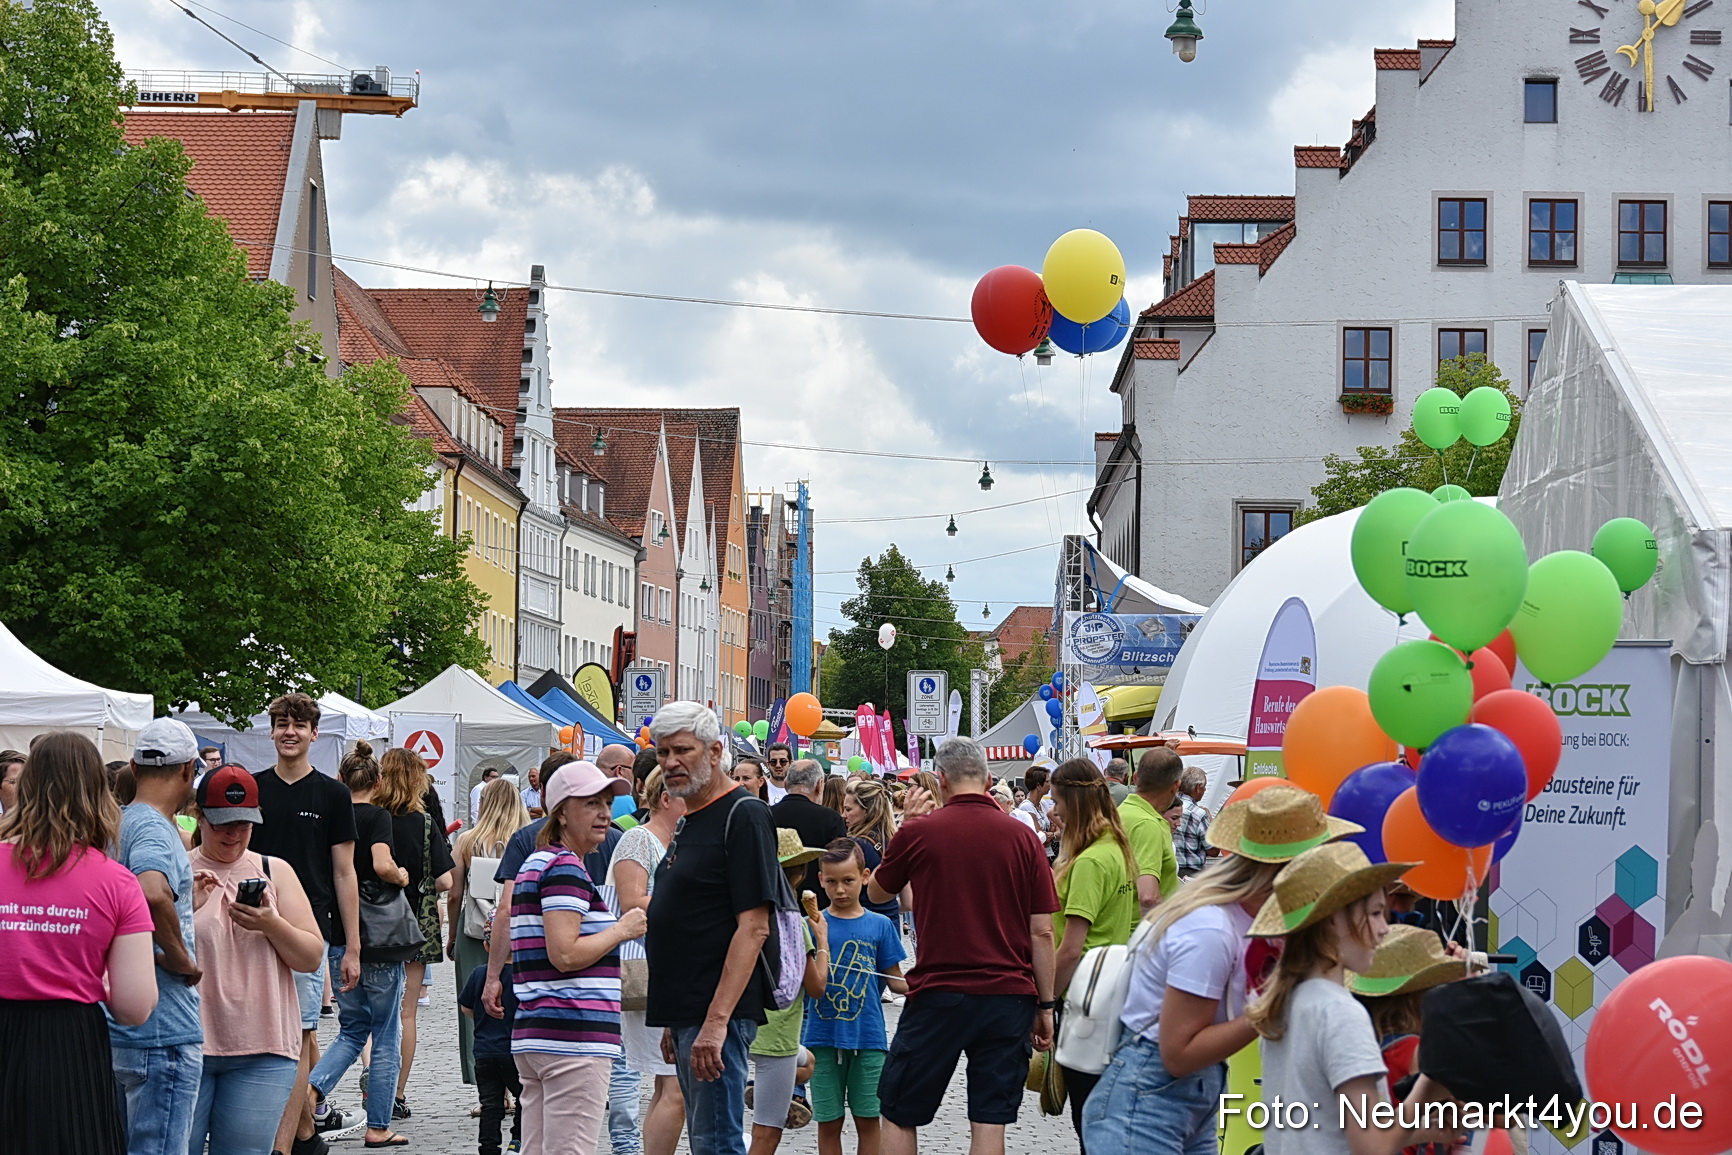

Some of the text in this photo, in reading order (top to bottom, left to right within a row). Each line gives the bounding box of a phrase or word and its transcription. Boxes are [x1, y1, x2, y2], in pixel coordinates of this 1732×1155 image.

[136, 92, 196, 102] BHERR
[1406, 558, 1469, 578] BOCK
[1073, 632, 1125, 646] PRÖPSTER
[1121, 651, 1174, 663] Blitzsch
[1263, 695, 1285, 713] Berufe
[1254, 716, 1286, 734] Hauswirts
[1561, 732, 1630, 750] ung bei BOCK:
[1253, 762, 1280, 777] Entdecke,
[1542, 775, 1641, 801] Bausteine für
[1524, 803, 1627, 831] Deine Zukunft.
[21, 905, 44, 916] uns
[47, 904, 89, 920] durch!
[0, 919, 81, 935] turzündstoff
[1648, 997, 1712, 1086] RÖDL
